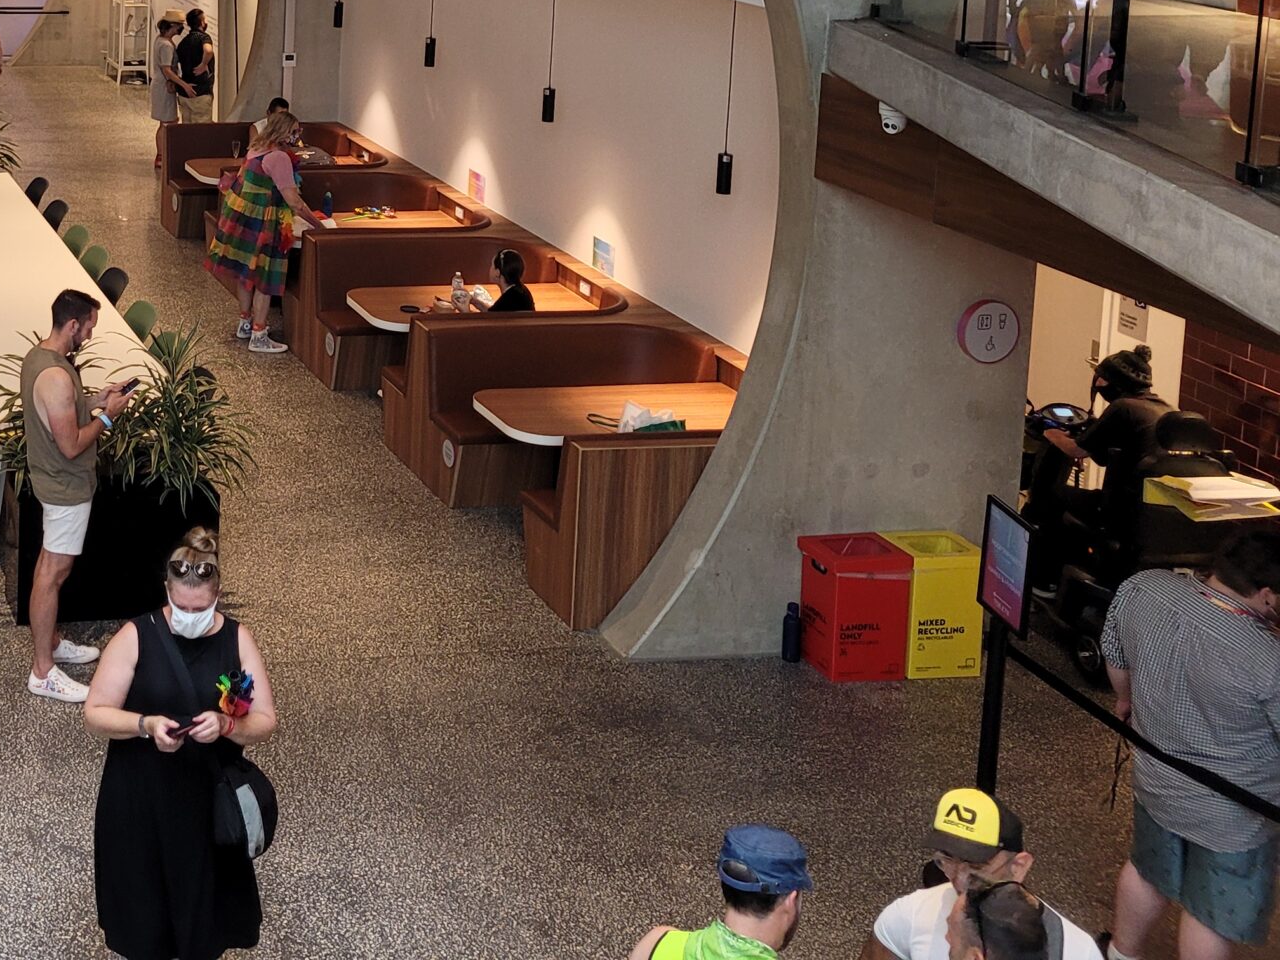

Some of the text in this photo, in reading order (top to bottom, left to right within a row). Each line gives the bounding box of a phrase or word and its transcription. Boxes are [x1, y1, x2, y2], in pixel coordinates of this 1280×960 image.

[840, 623, 880, 632] LANDFILL
[917, 626, 965, 635] RECYCLING
[840, 632, 863, 640] ONLY
